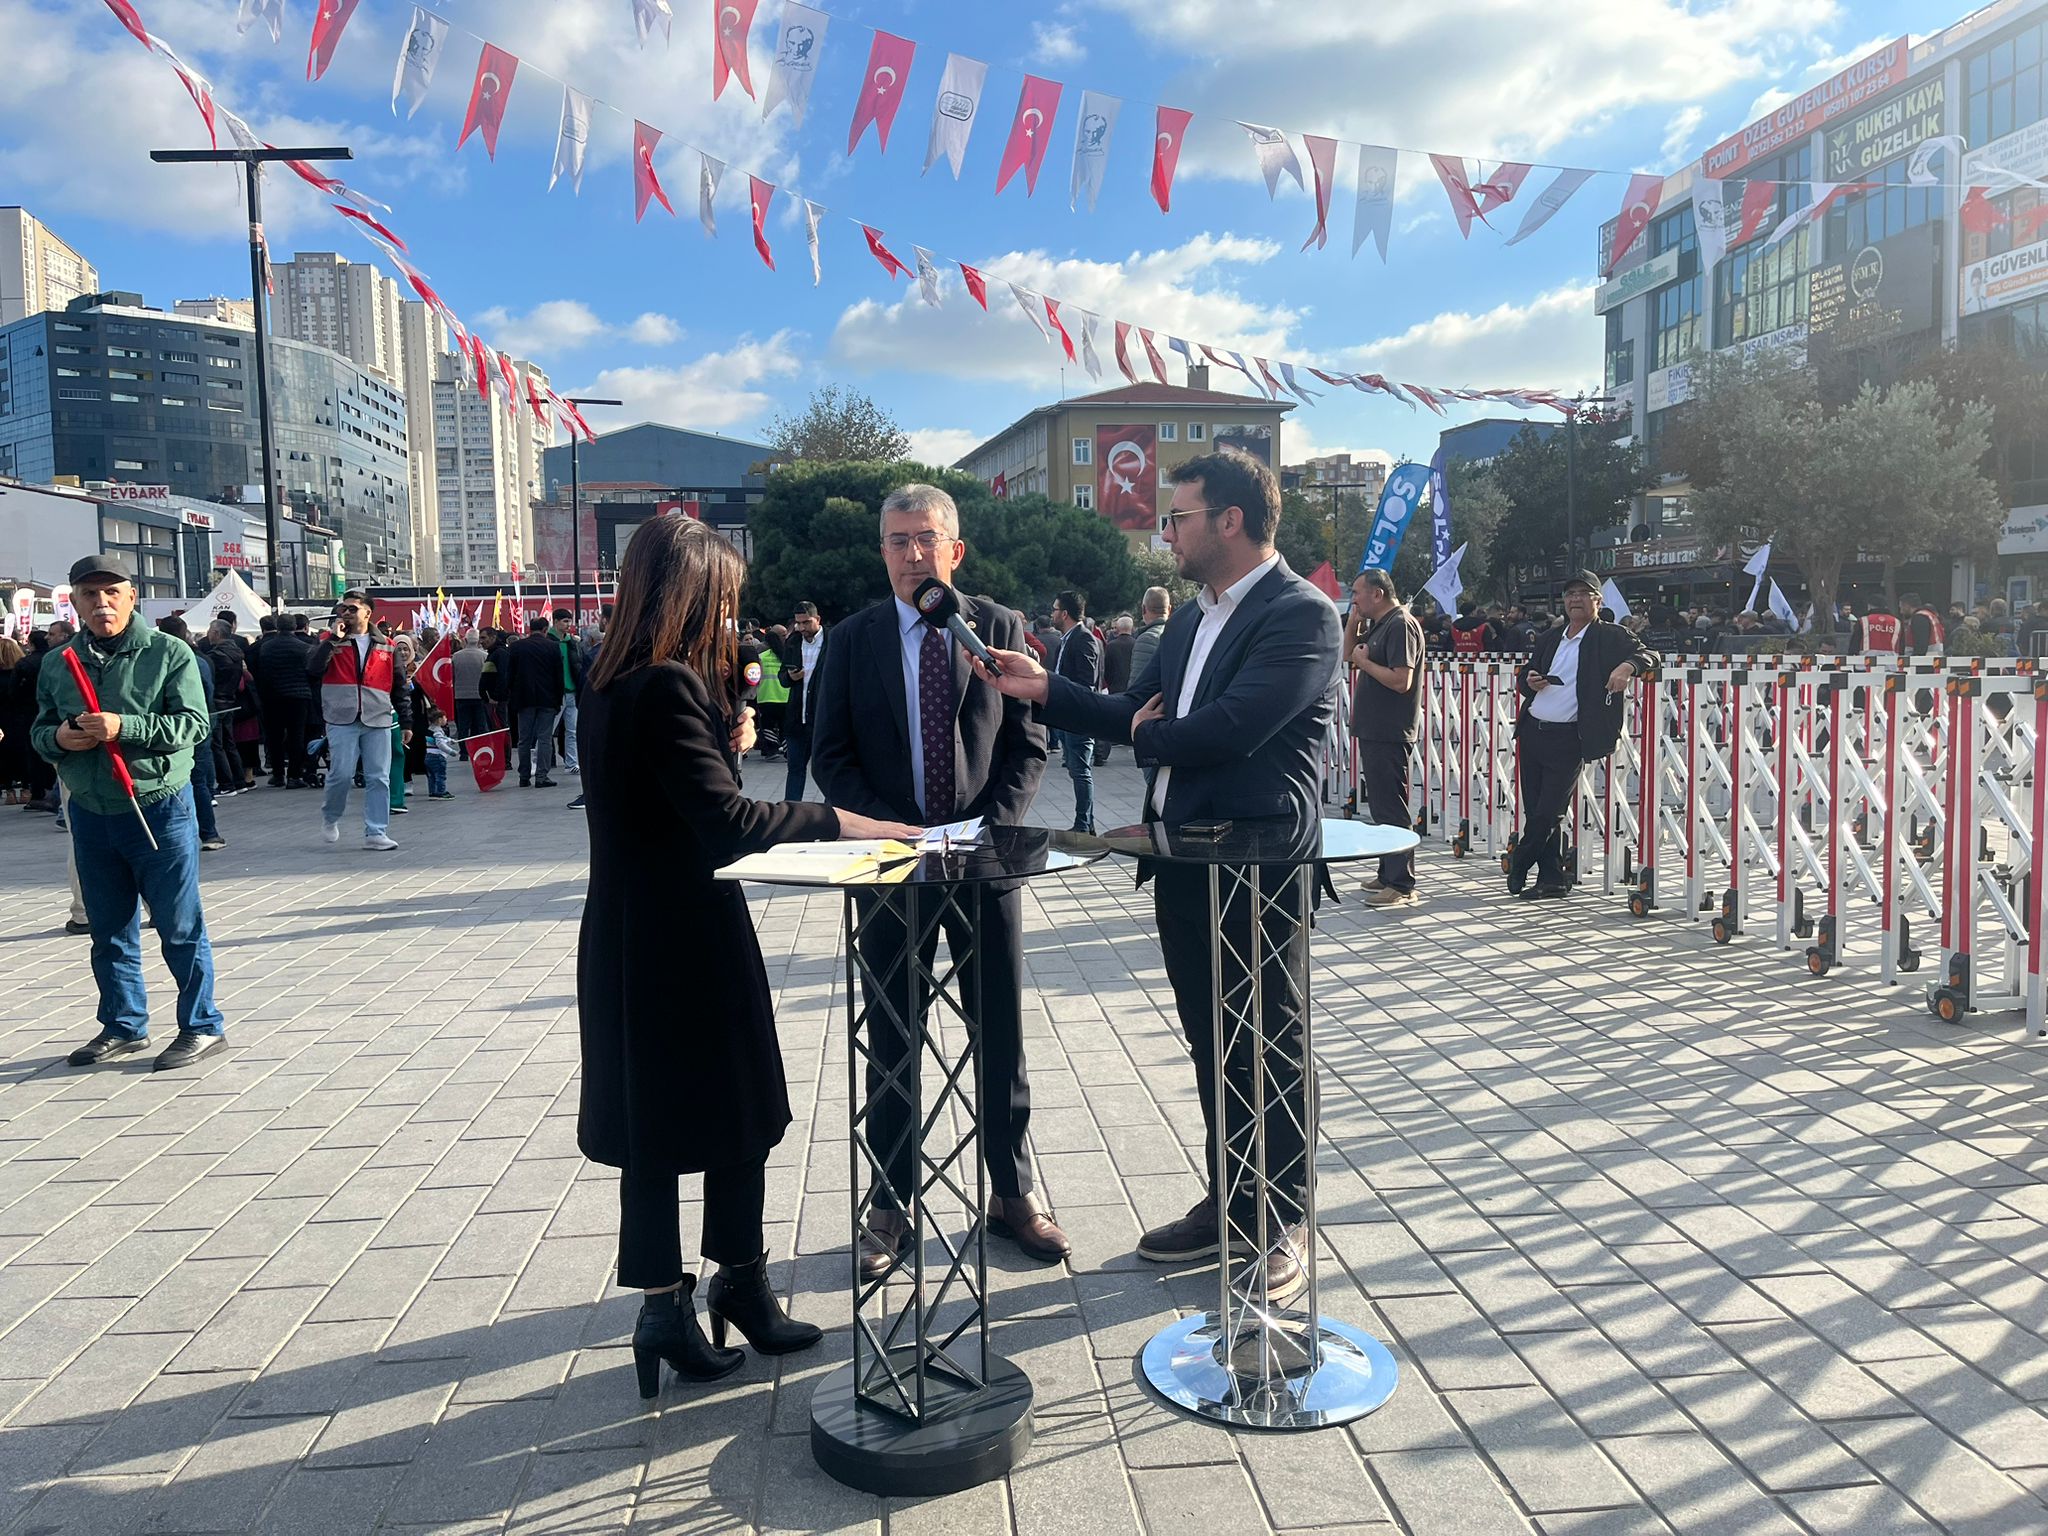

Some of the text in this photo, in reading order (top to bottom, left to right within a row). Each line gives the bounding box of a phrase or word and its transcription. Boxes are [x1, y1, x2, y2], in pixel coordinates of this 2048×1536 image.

[1856, 80, 1944, 144] RUKEN KAYA
[1861, 113, 1940, 168] GÜZELLİK
[110, 487, 168, 500] EVBARK
[186, 512, 211, 526] EVBARK
